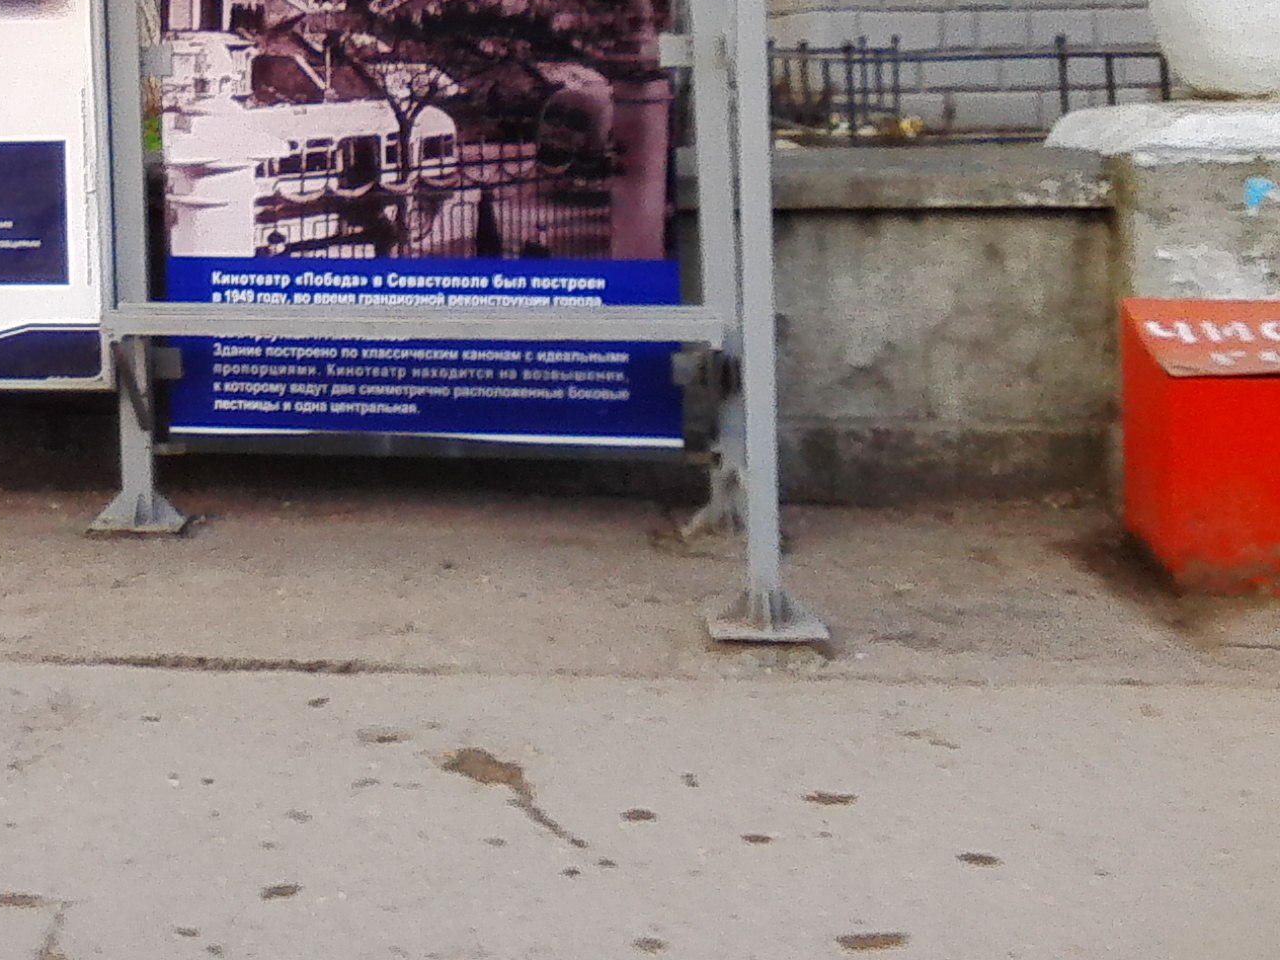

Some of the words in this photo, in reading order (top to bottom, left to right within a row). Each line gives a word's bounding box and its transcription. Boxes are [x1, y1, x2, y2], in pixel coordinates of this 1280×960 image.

[212, 271, 290, 288] Кинотеатр
[295, 272, 368, 288] «Победа»
[372, 276, 382, 287] в
[387, 273, 489, 288] Севастополе
[493, 274, 527, 289] был
[531, 278, 606, 291] построен
[213, 343, 262, 357] Здание
[266, 346, 337, 360] построено
[341, 347, 358, 357] по
[362, 347, 458, 359] классическим
[462, 350, 520, 361] канонам
[525, 351, 533, 361] с
[537, 351, 629, 363] идеальными
